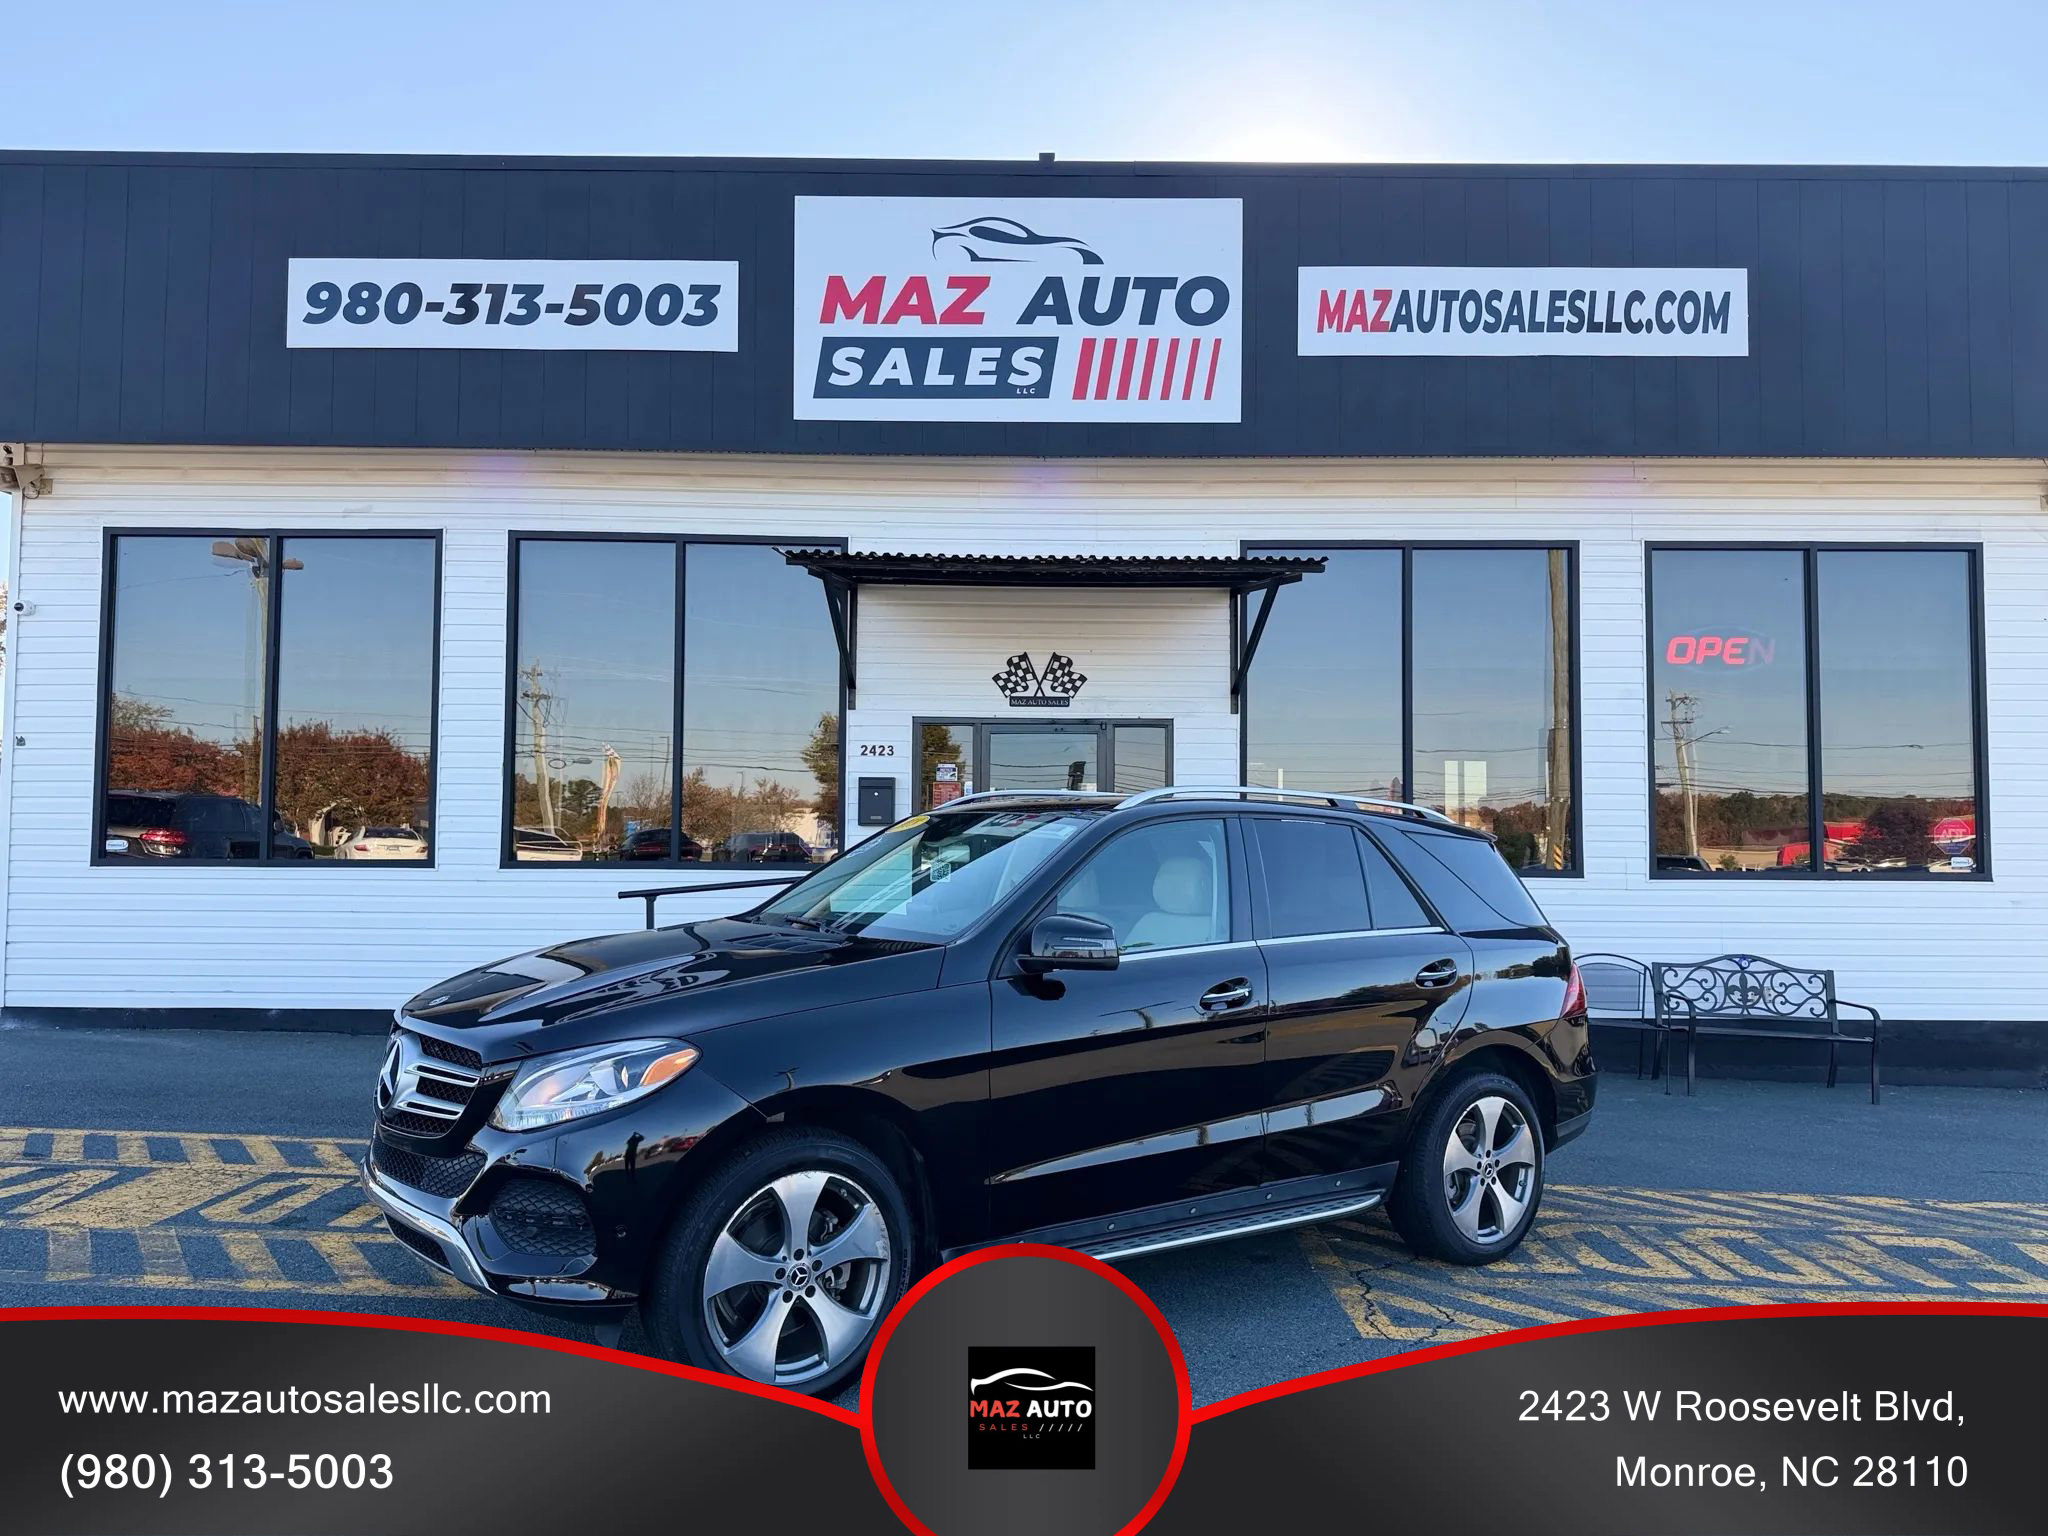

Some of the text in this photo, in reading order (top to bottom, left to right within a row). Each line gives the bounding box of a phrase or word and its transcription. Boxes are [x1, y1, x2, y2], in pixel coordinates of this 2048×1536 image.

[302, 281, 722, 327] 980-313-5003
[819, 275, 1230, 327] MAZ AUTO
[1316, 288, 1731, 335] MAZAUTOSALESLLC.COM
[828, 346, 1045, 386] SALES
[1016, 387, 1036, 395] LLC
[1665, 636, 1776, 665] OPEN
[860, 744, 895, 757] 2423
